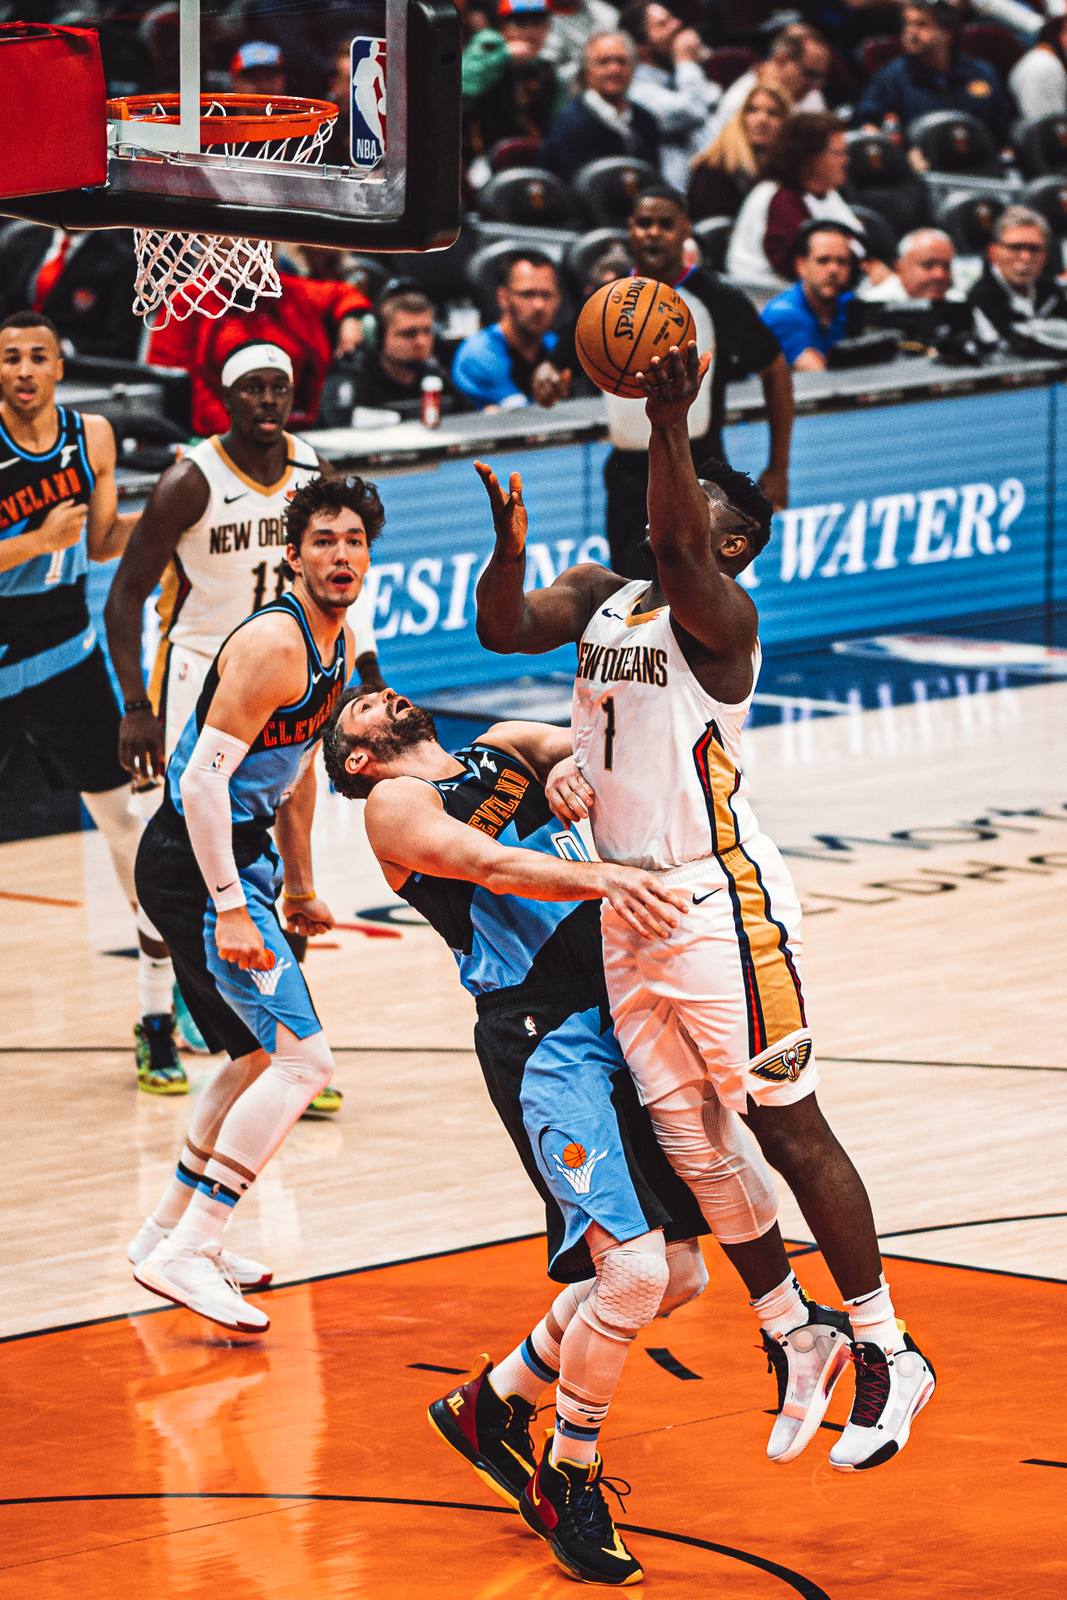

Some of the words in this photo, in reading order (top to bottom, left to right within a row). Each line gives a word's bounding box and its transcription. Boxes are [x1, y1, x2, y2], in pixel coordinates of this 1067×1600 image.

[356, 138, 378, 160] NBA
[614, 279, 648, 340] SPALDIN
[209, 520, 252, 554] NEW
[780, 477, 1025, 583] WATER?
[576, 642, 605, 680] EW
[601, 695, 616, 772] 1
